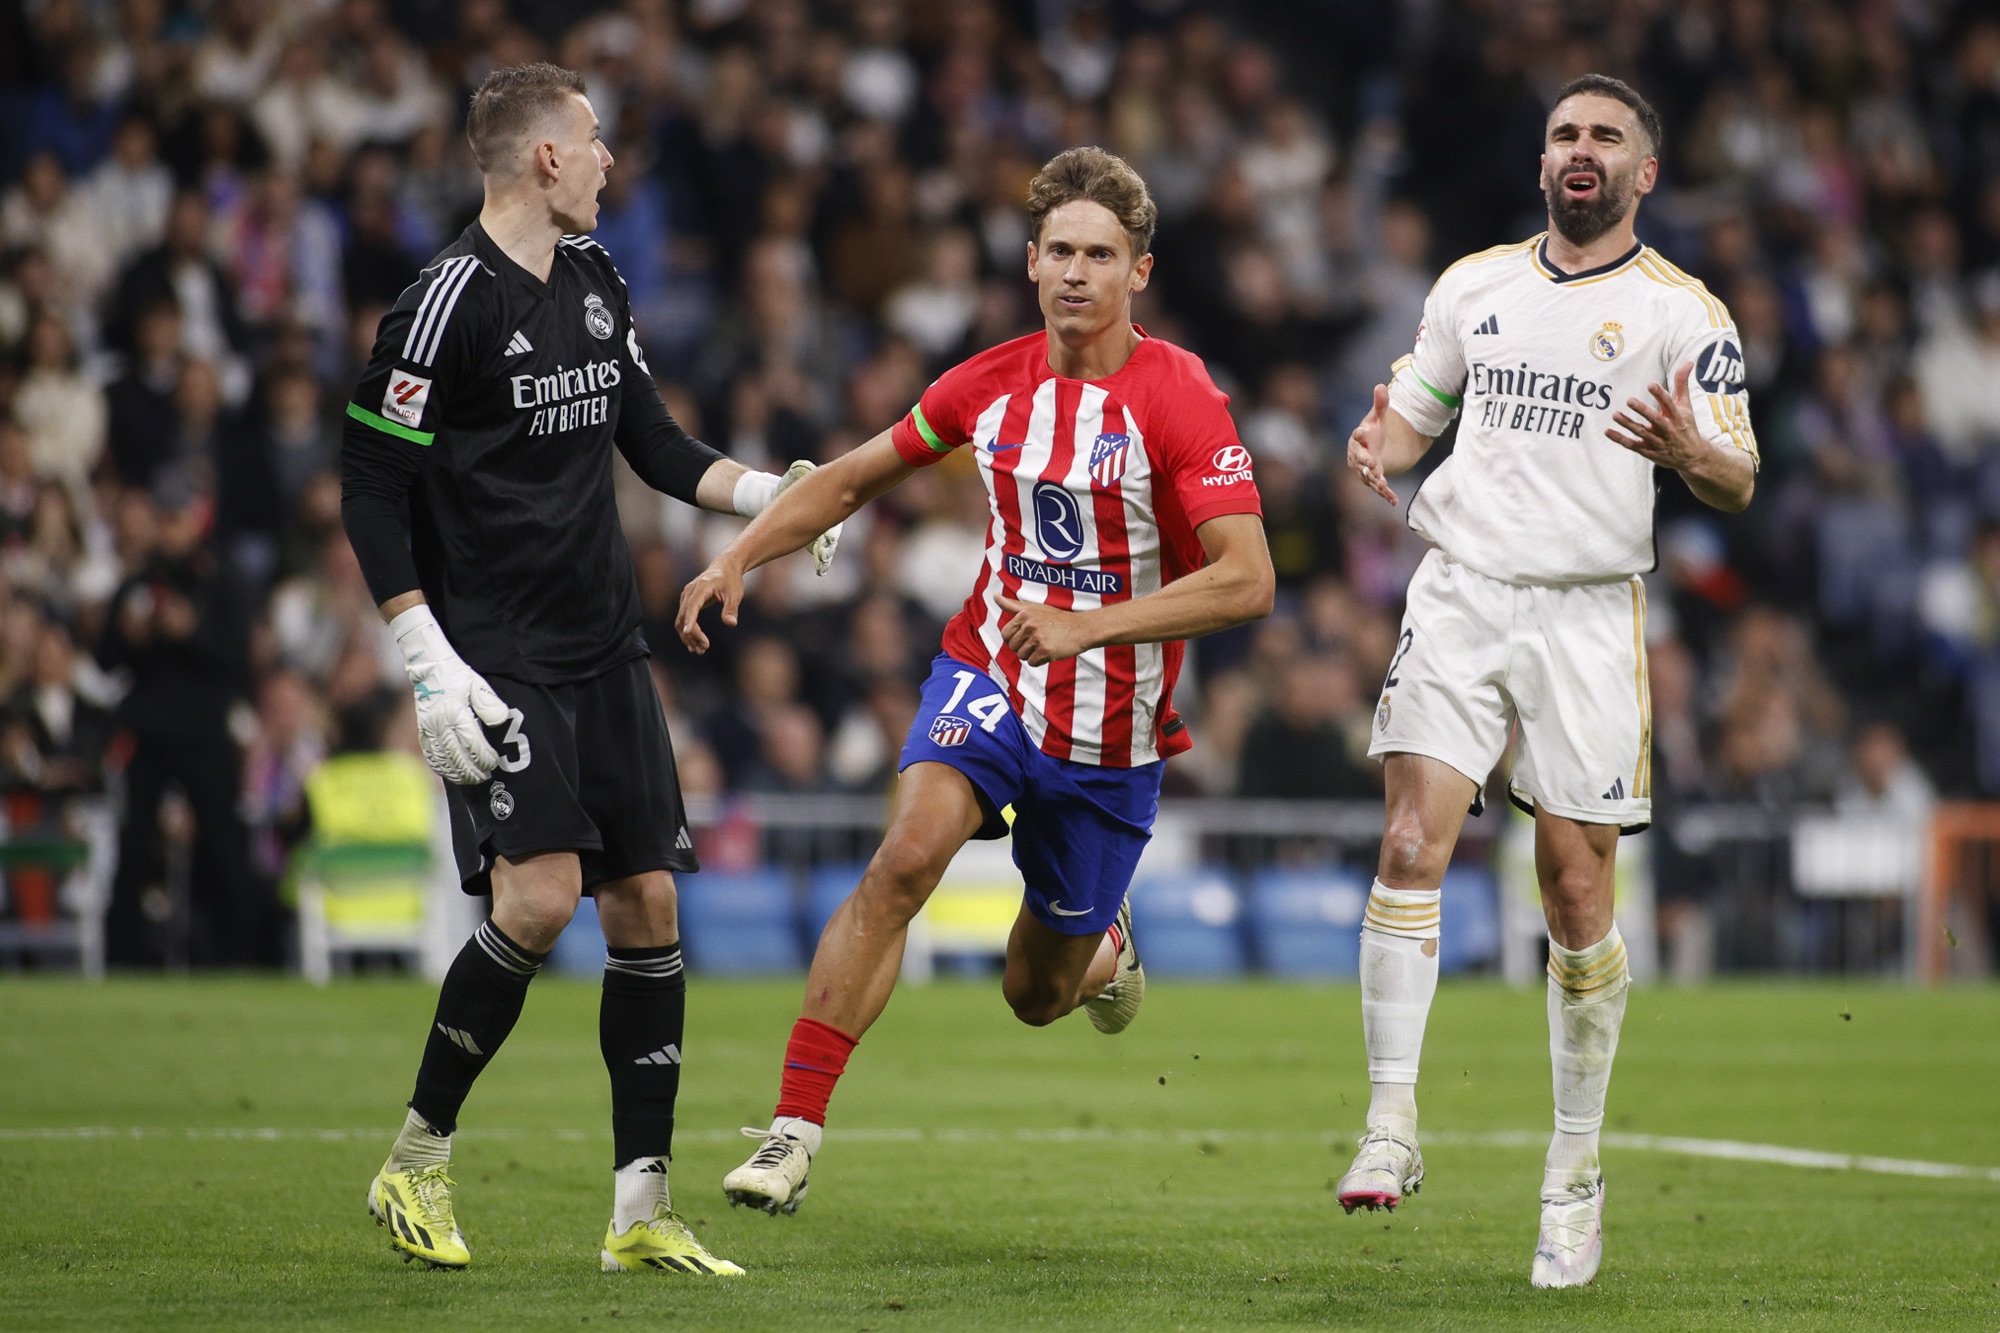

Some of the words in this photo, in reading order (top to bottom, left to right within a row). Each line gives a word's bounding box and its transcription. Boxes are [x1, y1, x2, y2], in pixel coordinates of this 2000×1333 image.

[510, 359, 621, 409] Emirates
[1473, 362, 1612, 410] Emirates
[387, 405, 416, 420] LALIGA
[528, 407, 558, 436] FLY
[559, 395, 608, 432] BETTER
[1481, 401, 1507, 428] FLY
[1510, 404, 1584, 439] BETTER
[1009, 556, 1075, 588] RIYADH
[1081, 572, 1117, 592] AIR
[1385, 627, 1413, 688] 2
[939, 670, 1010, 733] 14
[499, 708, 531, 773] 3
